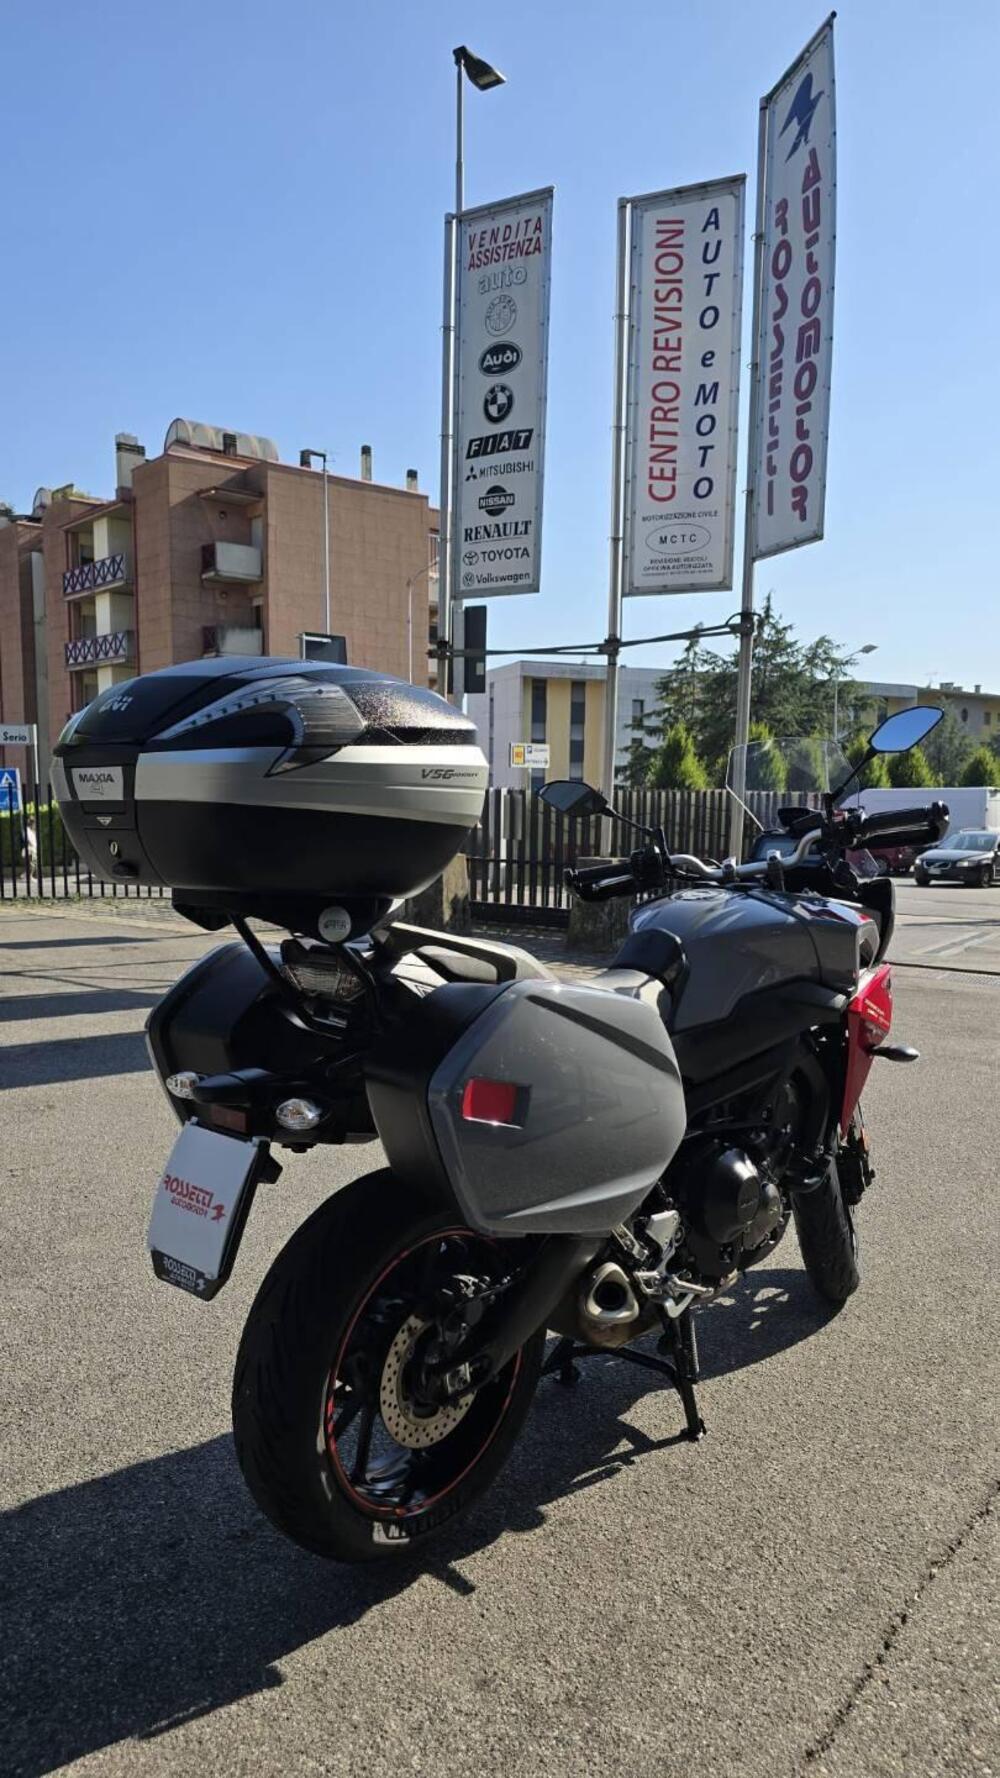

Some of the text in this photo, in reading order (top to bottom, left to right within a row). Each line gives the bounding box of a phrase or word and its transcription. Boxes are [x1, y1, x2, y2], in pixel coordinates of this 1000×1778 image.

[468, 216, 543, 251] VENDITA
[467, 236, 542, 272] ASSISTENZA
[477, 265, 528, 295] auto
[482, 349, 517, 370] Audi
[648, 219, 685, 502] CENTRO REVISIONI
[693, 207, 722, 499] AUTO e MOTO
[467, 430, 532, 458] FIAT
[479, 460, 534, 478] MITSUBISHI
[480, 494, 514, 508] NISSAN
[697, 510, 718, 518] CIVILE
[464, 520, 533, 542] RENAULT
[659, 533, 697, 544] MCTC
[481, 547, 530, 563] TOYOTA
[475, 571, 531, 586] Volkswagen
[2, 731, 27, 742] Serio
[163, 1174, 214, 1209] ROSSETTI
